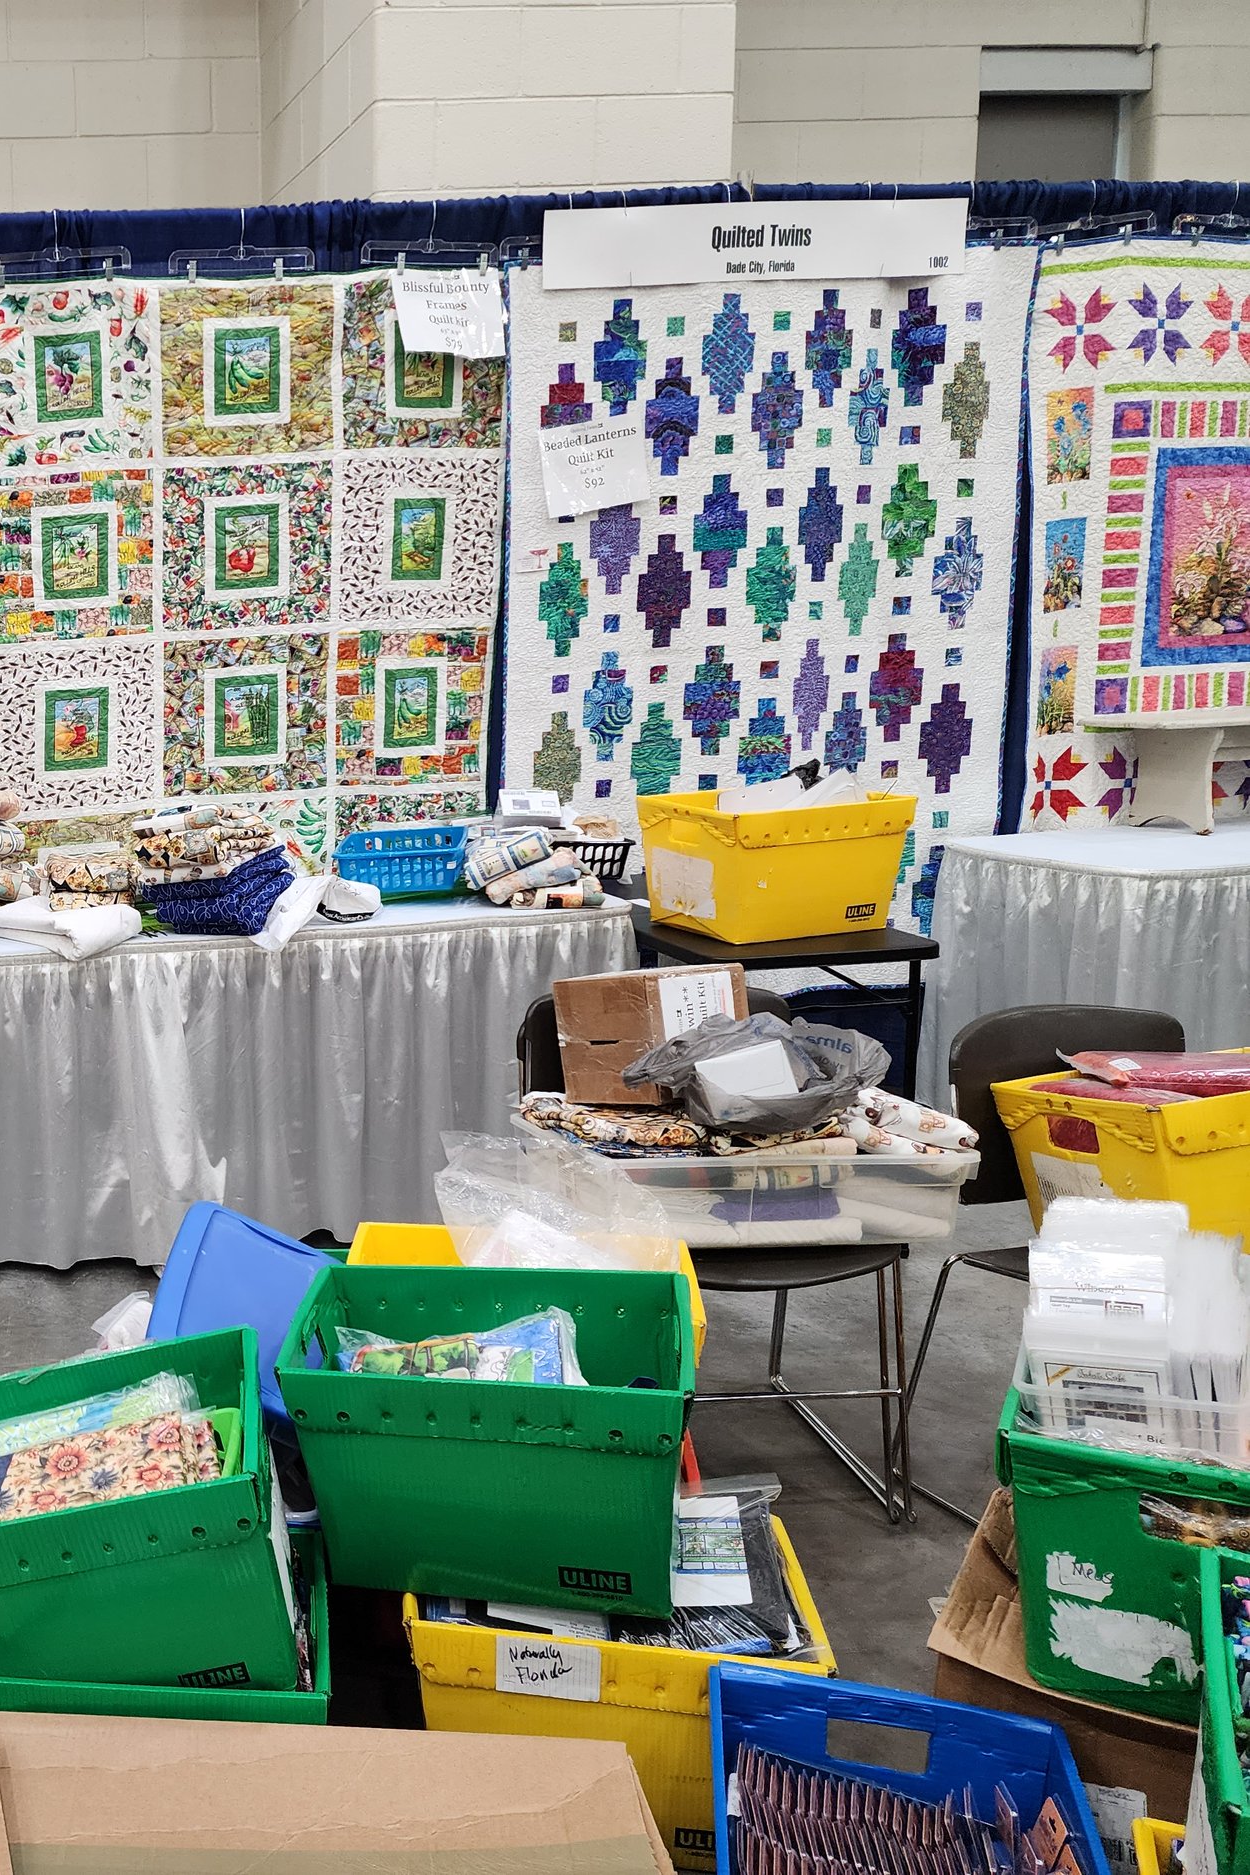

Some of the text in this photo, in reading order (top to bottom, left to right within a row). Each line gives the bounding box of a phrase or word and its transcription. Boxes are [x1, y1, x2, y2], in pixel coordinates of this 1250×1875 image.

[712, 224, 812, 252] Quilted Twins
[726, 260, 795, 275] Dade City, Florida
[928, 256, 949, 269] 1002
[402, 281, 489, 294] Blissful Bounty
[426, 299, 467, 311] Frames
[428, 314, 453, 325] Quilt
[543, 436, 582, 452] Beaded
[584, 426, 637, 444] Lanterns
[568, 447, 614, 466] Quilt Kit
[584, 477, 605, 489] $92
[847, 904, 874, 917] ULINE
[697, 981, 708, 1022] uilt Kit
[563, 1570, 627, 1591] ULINE
[509, 1644, 563, 1666] Naturally
[182, 1666, 246, 1686] ULINE
[515, 1662, 573, 1684] Florida
[679, 1831, 713, 1849] ULI
